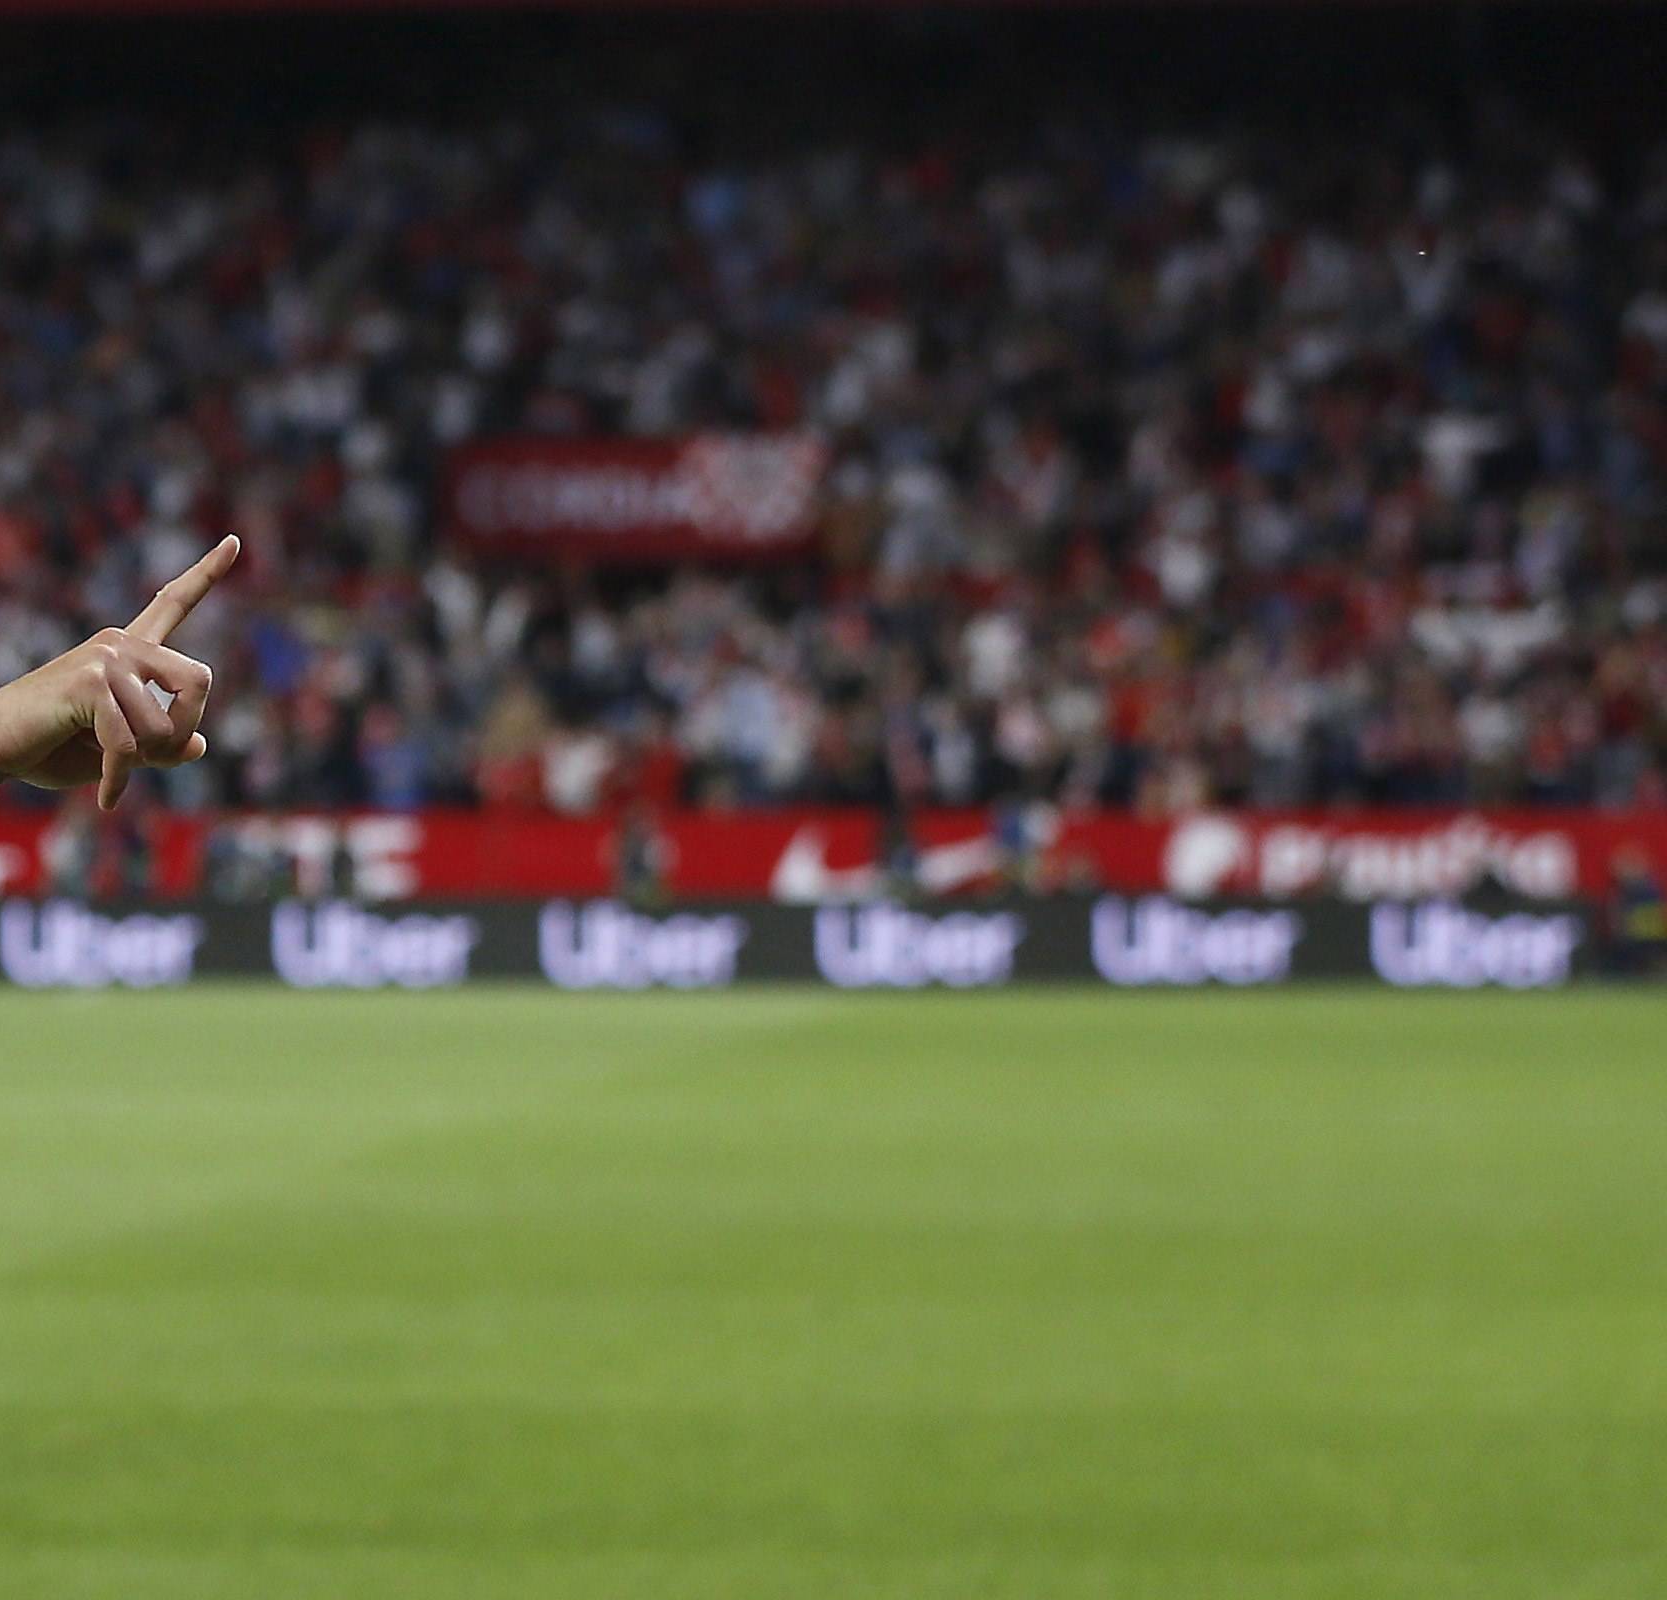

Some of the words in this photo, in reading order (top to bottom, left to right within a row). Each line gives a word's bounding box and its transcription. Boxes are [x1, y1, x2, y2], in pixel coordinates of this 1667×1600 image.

[270, 899, 478, 988] Uber
[538, 899, 748, 988] Uber
[814, 899, 1025, 988] Uber
[1091, 894, 1302, 986] Uber
[1369, 898, 1581, 988] Uber
